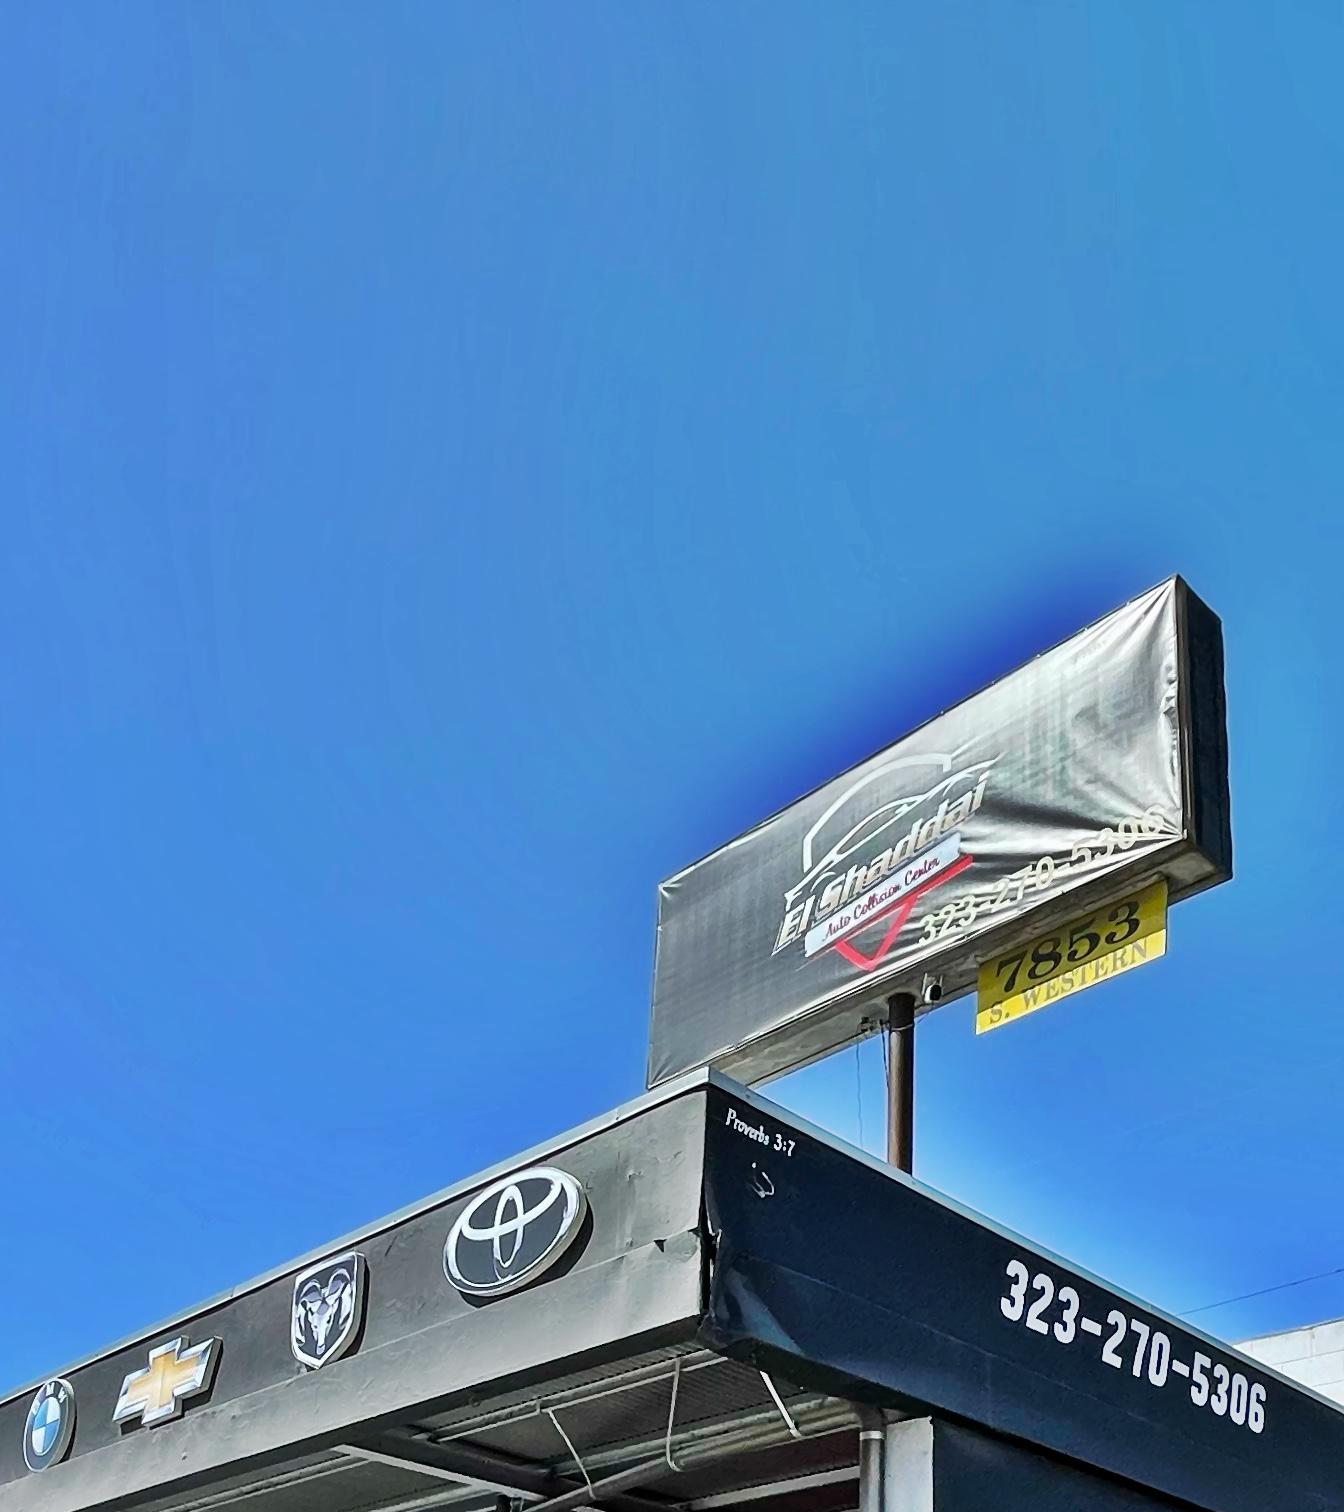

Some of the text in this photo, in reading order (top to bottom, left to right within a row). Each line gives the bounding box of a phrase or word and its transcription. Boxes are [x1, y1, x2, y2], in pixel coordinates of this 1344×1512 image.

[771, 770, 990, 955] El Shaddai
[822, 857, 941, 941] Auto Collision Center
[917, 804, 1168, 946] 323-270-5306
[989, 938, 1147, 1026] S. WESTERN
[995, 900, 1141, 994] 7853
[725, 1107, 796, 1157] Proverbs 3:7
[1000, 1259, 1267, 1434] 323-270-5306
